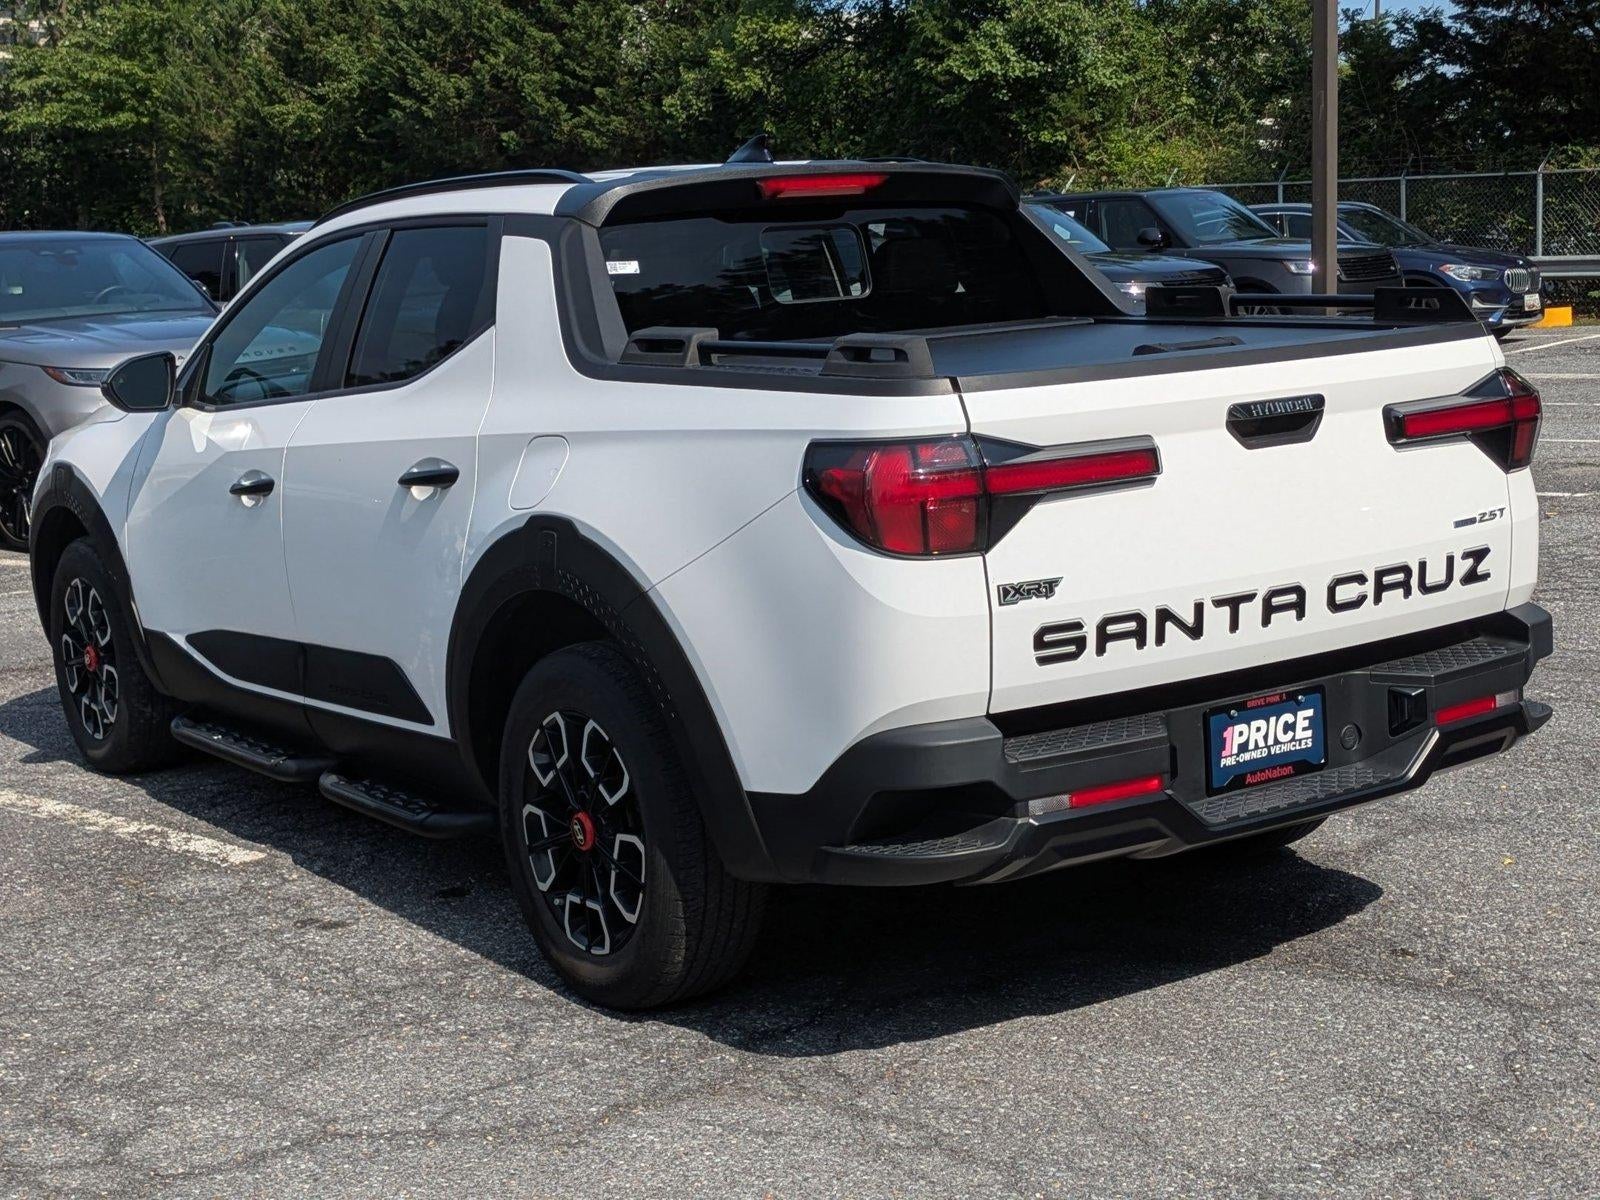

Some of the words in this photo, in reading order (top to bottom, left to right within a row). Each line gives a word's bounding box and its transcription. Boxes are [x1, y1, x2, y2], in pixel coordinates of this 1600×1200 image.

[1251, 398, 1313, 416] HYUNDAI
[999, 577, 1063, 605] XRT
[1033, 581, 1307, 666] SANTA
[1326, 544, 1492, 614] CRUZ
[1220, 748, 1268, 768] PRE-OWNED
[1270, 738, 1312, 756] VEHICLES
[1245, 765, 1293, 784] AutoNation
